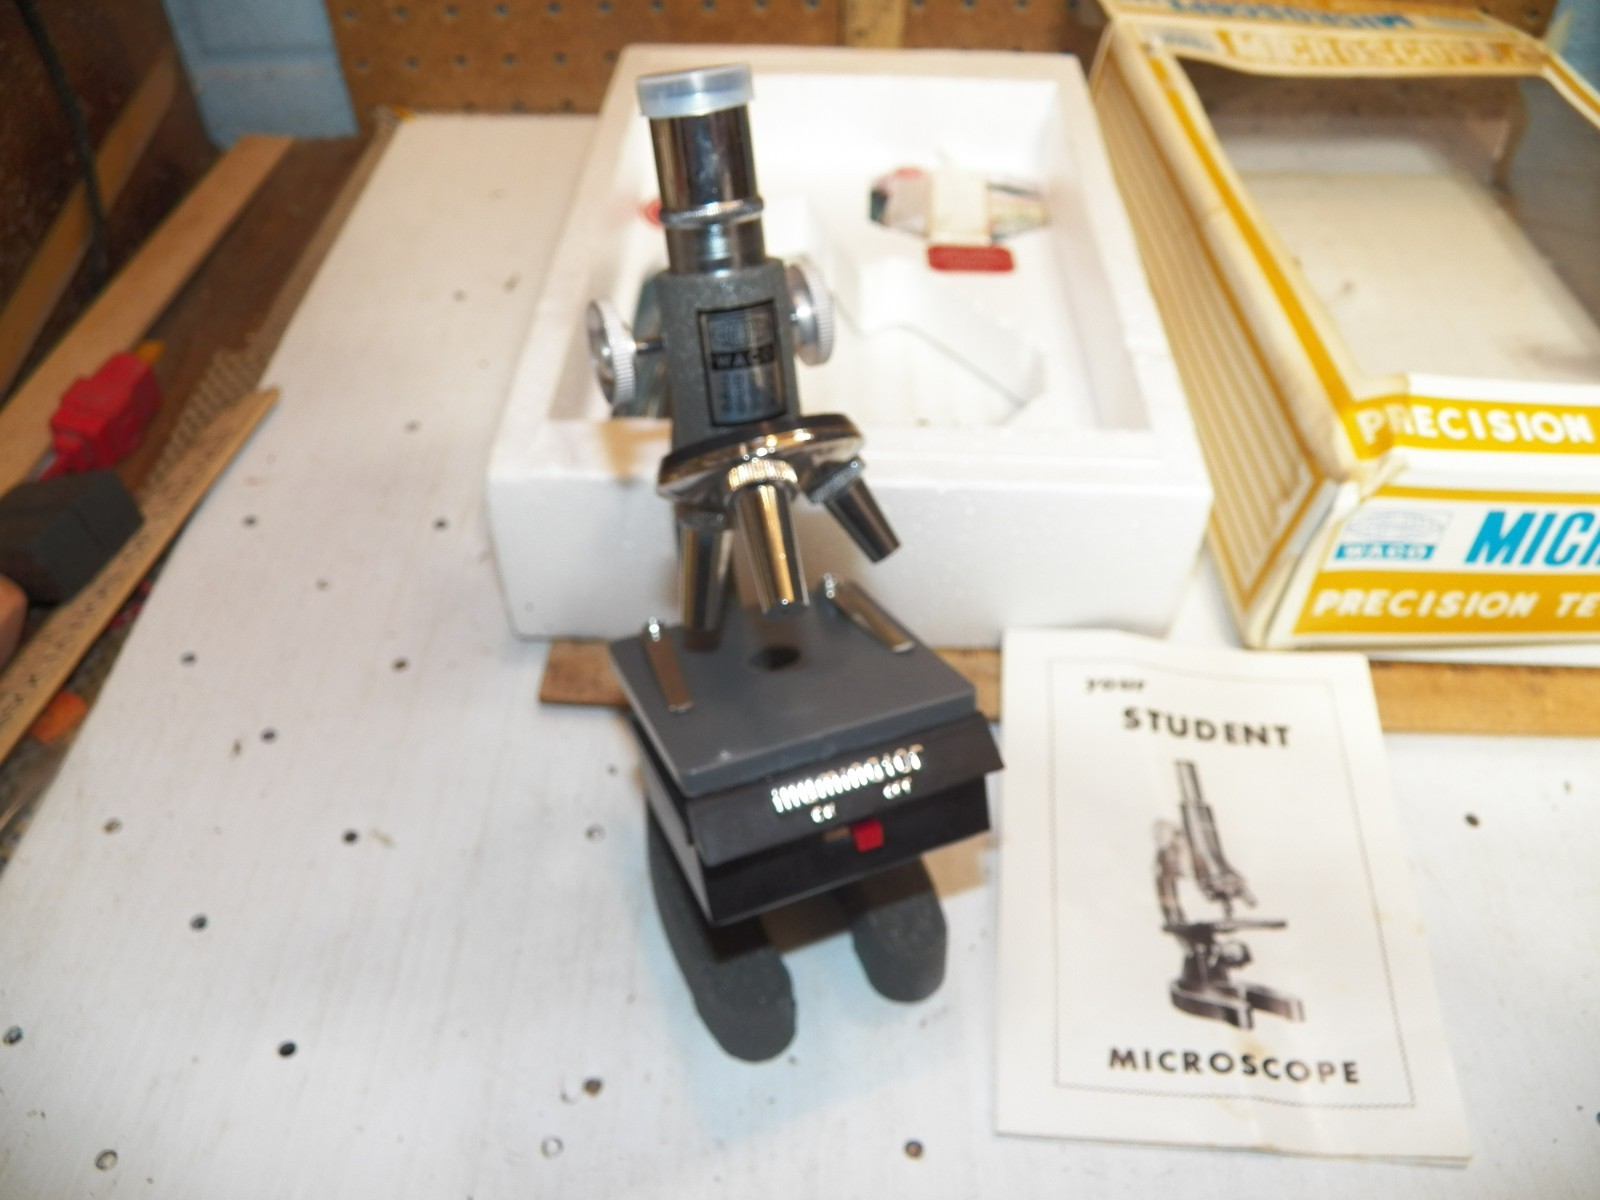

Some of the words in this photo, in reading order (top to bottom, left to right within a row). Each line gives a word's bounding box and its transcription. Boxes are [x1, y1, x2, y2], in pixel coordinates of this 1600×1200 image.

[1354, 403, 1595, 445] PRECISION
[1311, 588, 1540, 619] PRECISION
[1122, 706, 1292, 747] STUDENT
[1109, 1047, 1360, 1084] MICROSCOPE
